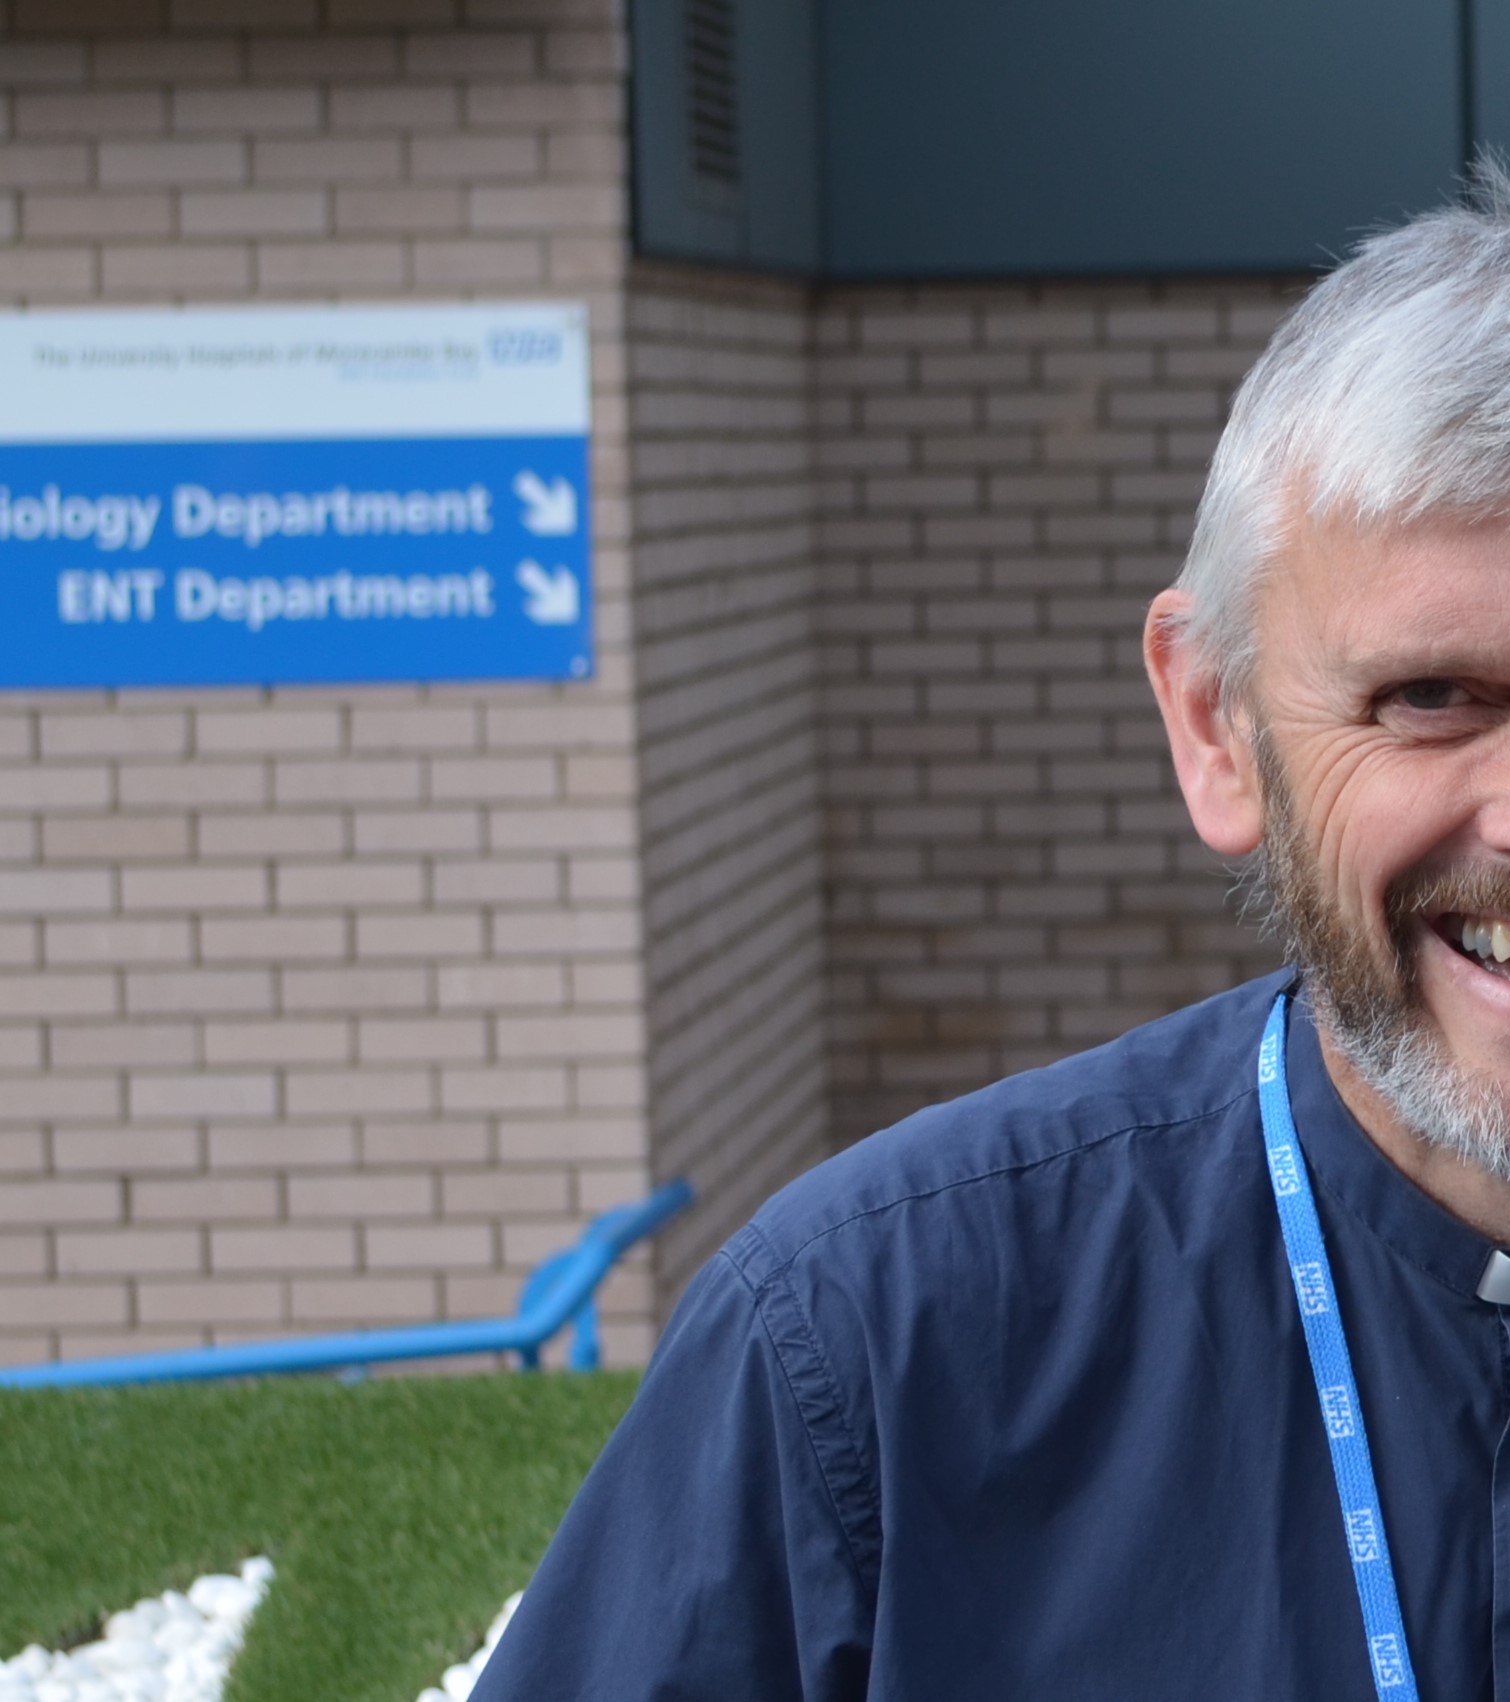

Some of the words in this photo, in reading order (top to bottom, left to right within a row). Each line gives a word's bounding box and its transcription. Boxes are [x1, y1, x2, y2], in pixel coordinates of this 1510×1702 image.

[172, 482, 493, 549] Department
[57, 567, 164, 623] ENT
[174, 566, 496, 632] Department
[1269, 1145, 1297, 1195] NHS
[1295, 1261, 1329, 1315] NHS
[1322, 1385, 1355, 1439] NHS
[1347, 1508, 1377, 1562] NHS
[1372, 1633, 1403, 1687] NHS
